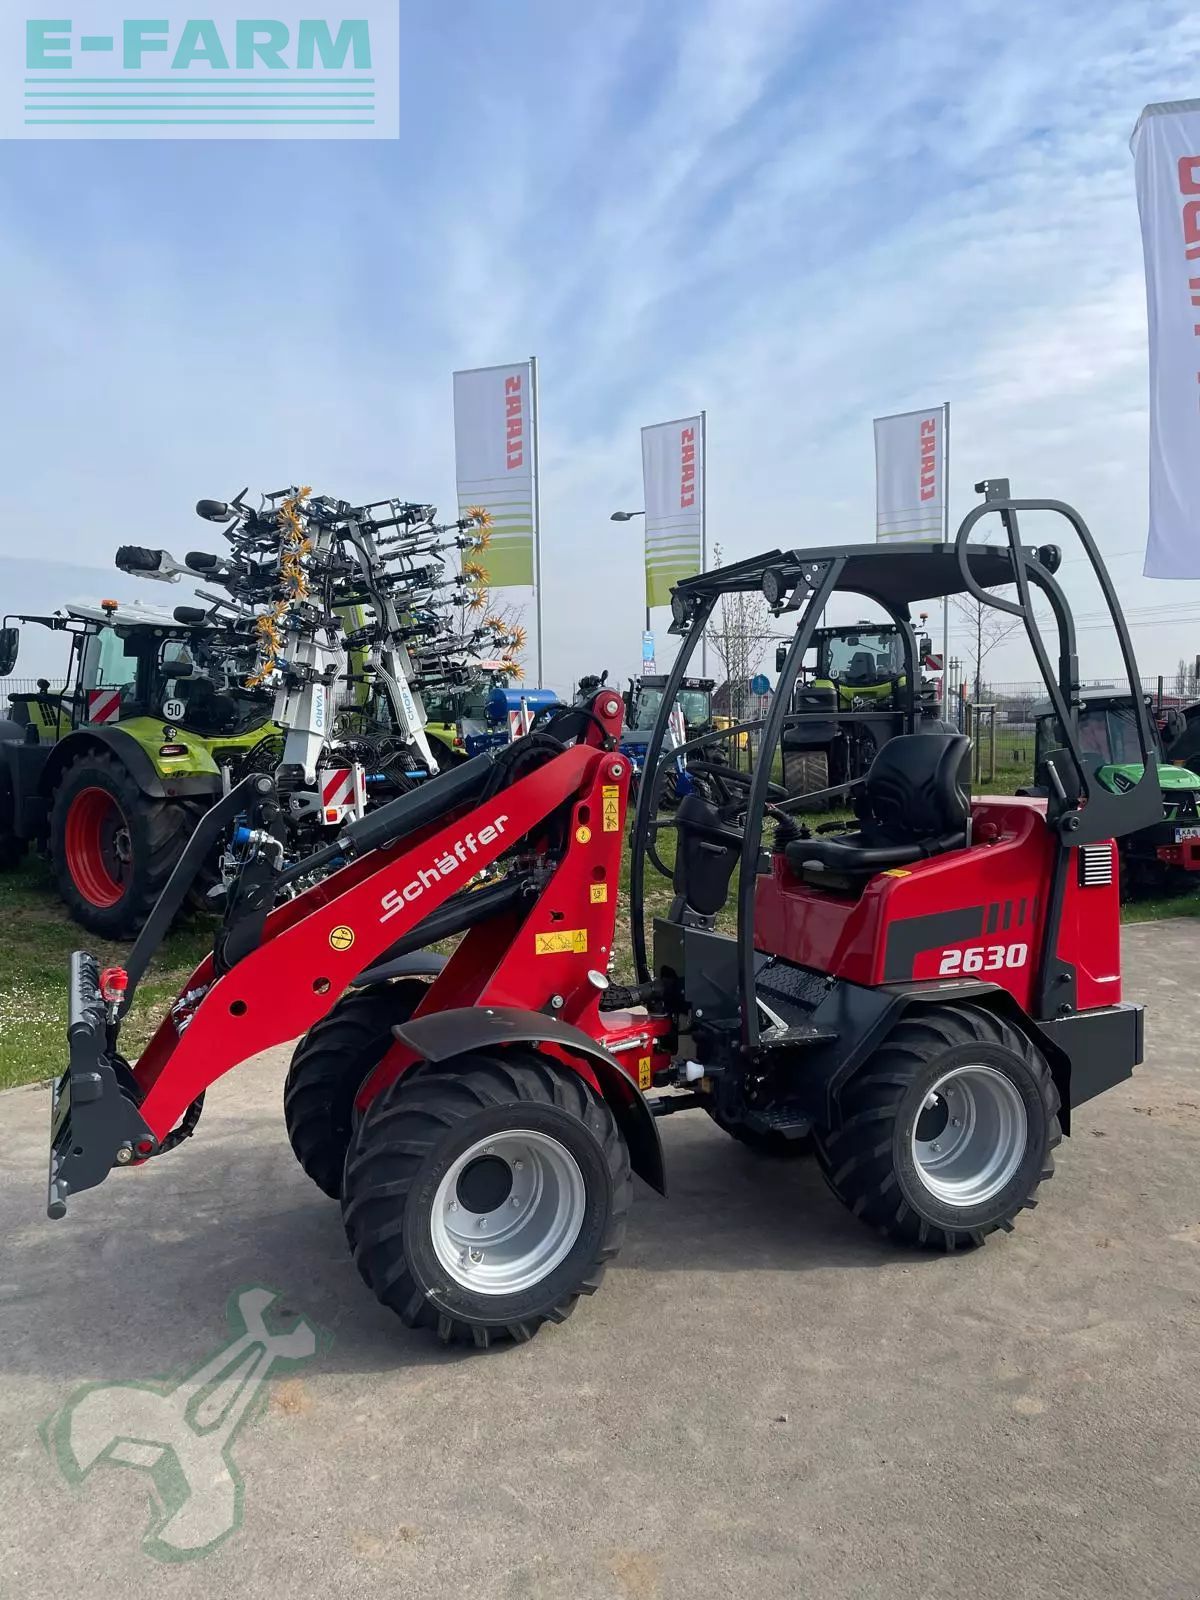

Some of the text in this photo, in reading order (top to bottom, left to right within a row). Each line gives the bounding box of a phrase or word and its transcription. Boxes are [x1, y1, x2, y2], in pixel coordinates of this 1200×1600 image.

[167, 703, 181, 717] 50
[379, 813, 509, 923] Schäffer
[939, 943, 1028, 975] 2630
